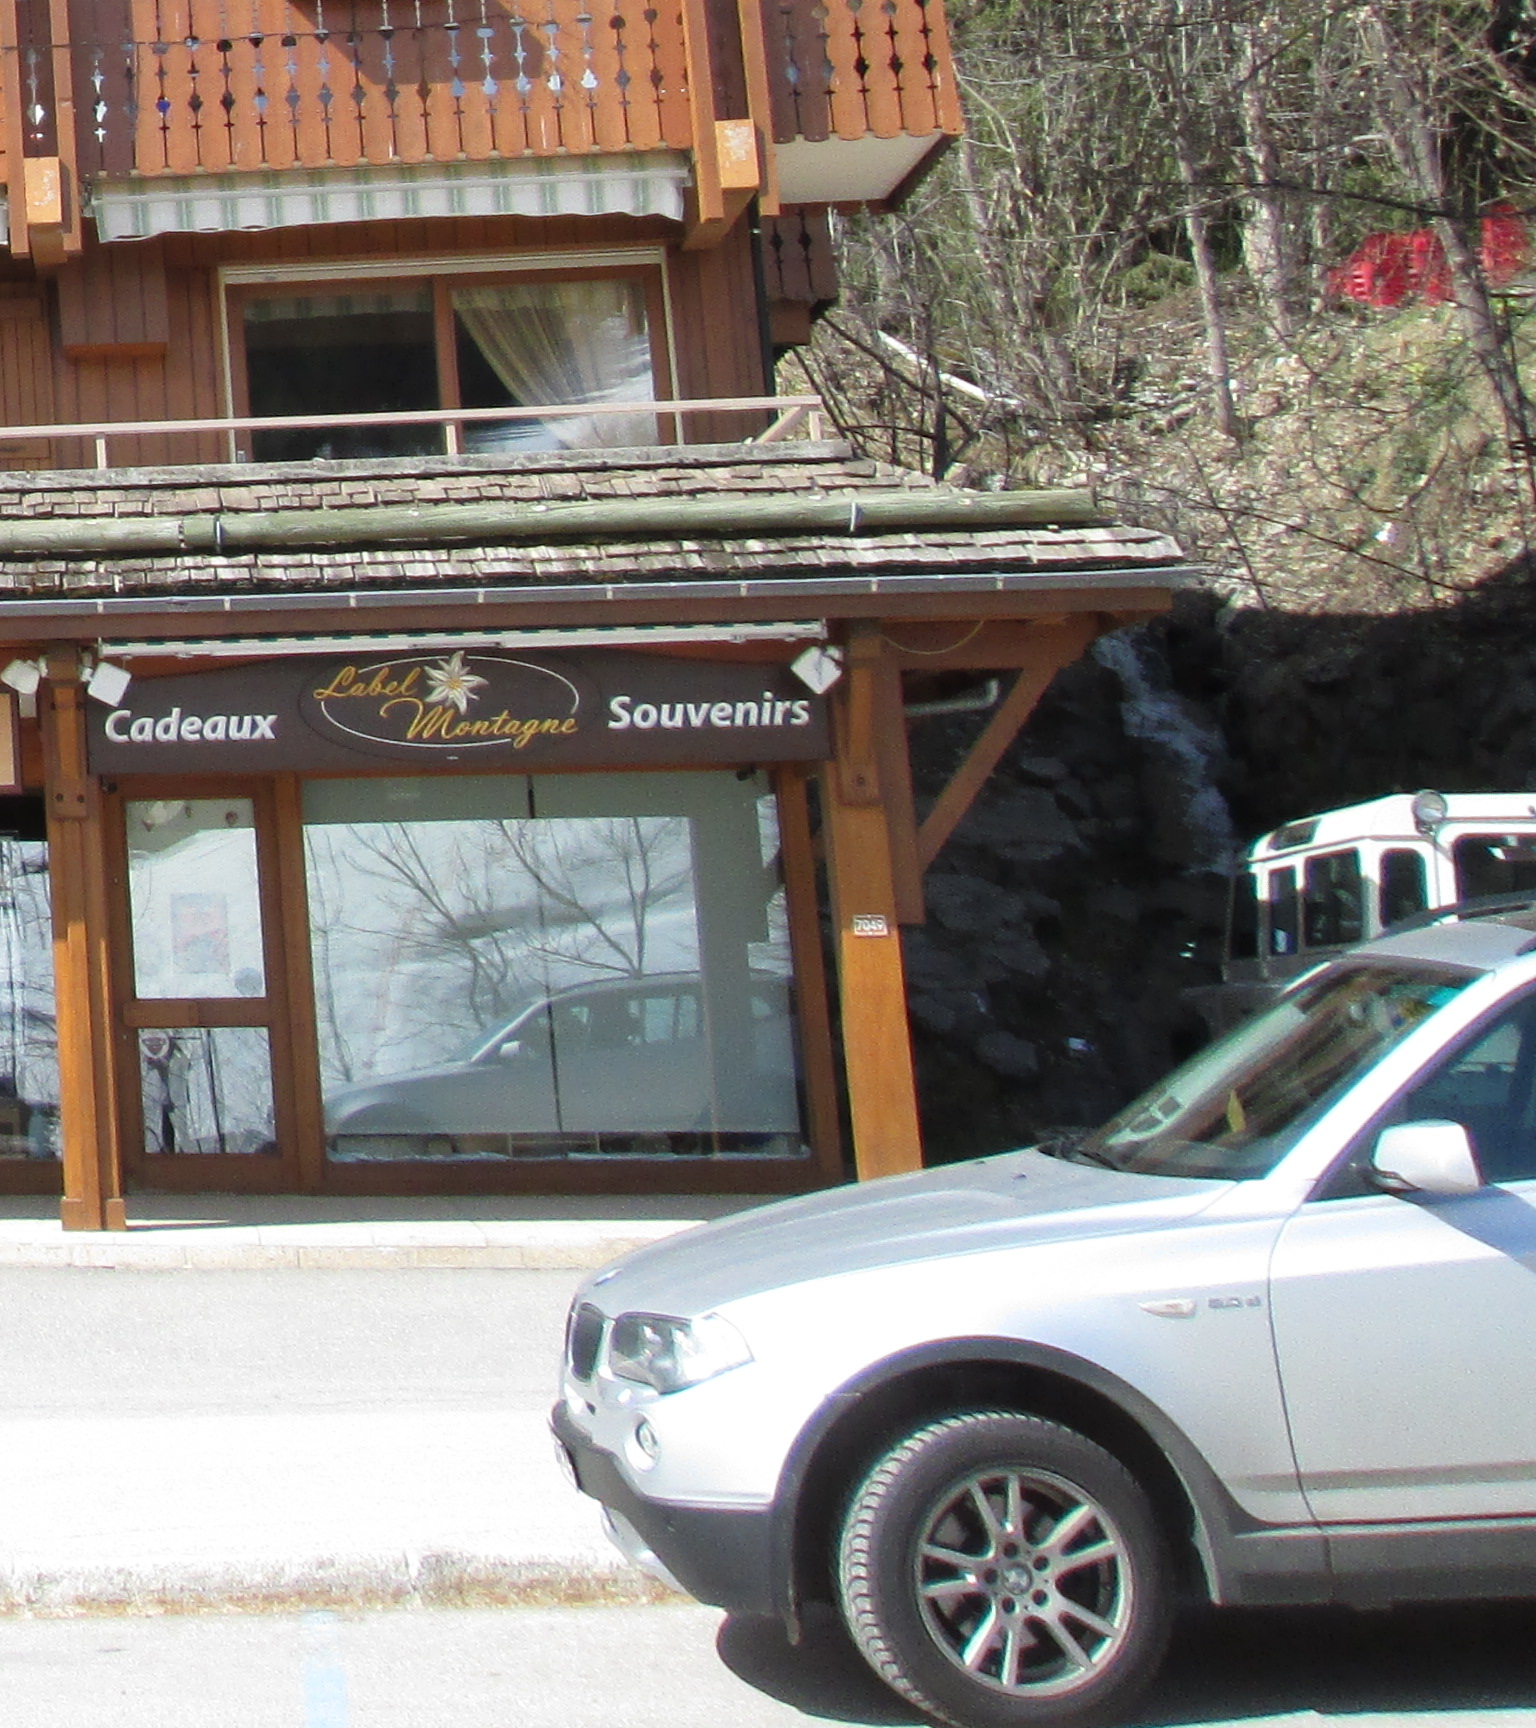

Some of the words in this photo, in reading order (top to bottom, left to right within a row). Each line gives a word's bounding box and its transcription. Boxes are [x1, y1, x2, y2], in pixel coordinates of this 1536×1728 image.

[313, 665, 421, 700] Label
[104, 707, 278, 743] Cadeaux
[379, 697, 579, 749] Montagne
[606, 691, 810, 730] Souvenirs
